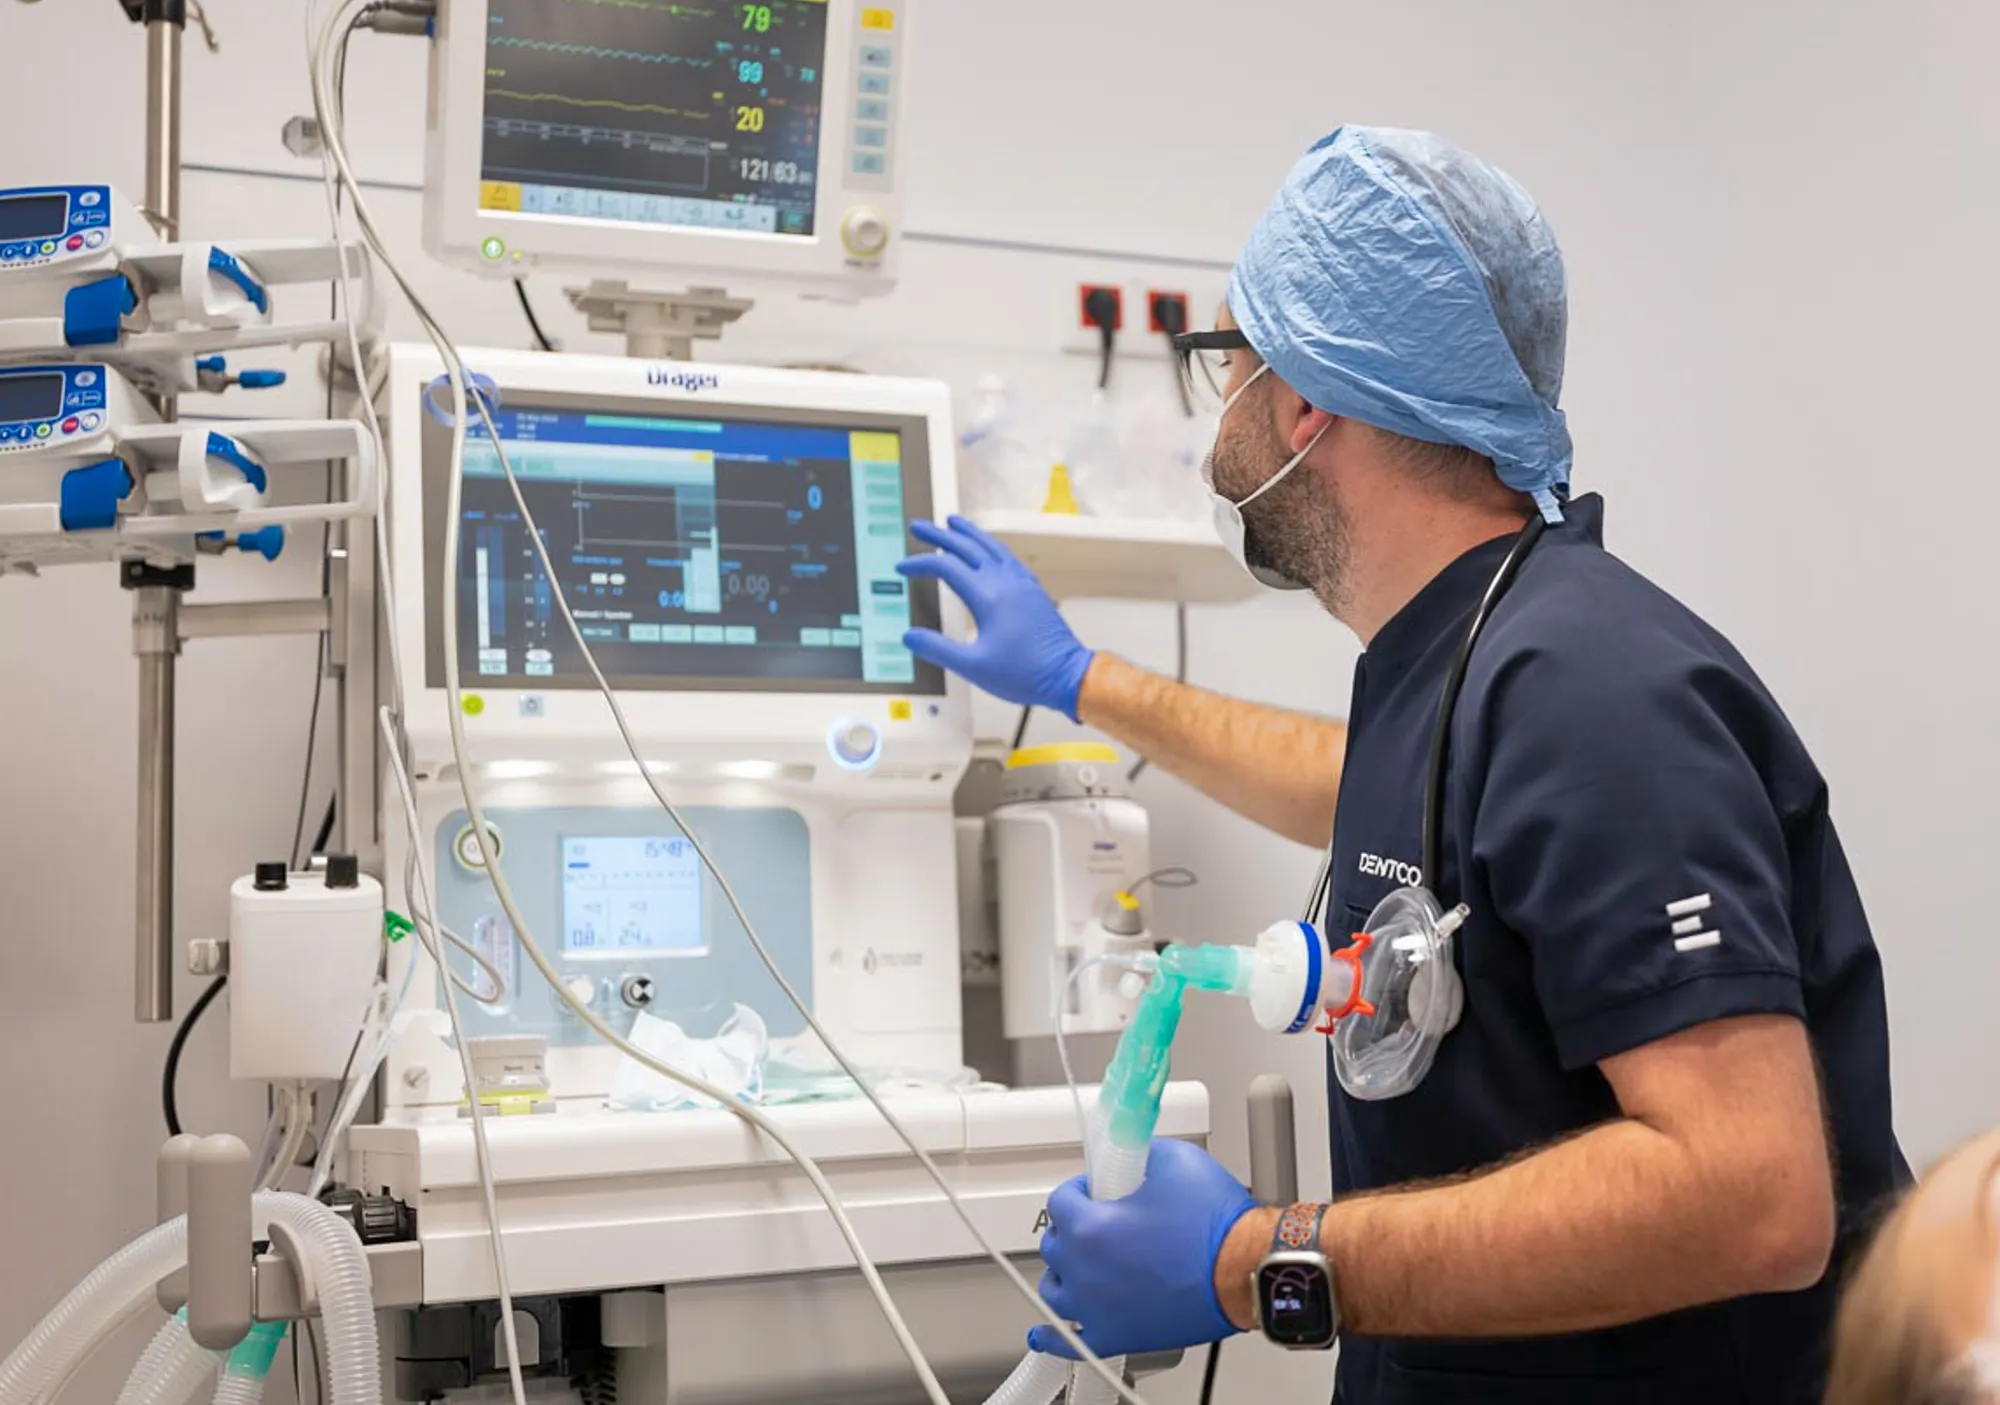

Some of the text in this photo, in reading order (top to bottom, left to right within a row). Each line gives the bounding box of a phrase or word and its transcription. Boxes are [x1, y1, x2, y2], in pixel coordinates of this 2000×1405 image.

[736, 106, 764, 132] 20
[741, 158, 769, 181] 121
[1359, 852, 1422, 888] DENTCO
